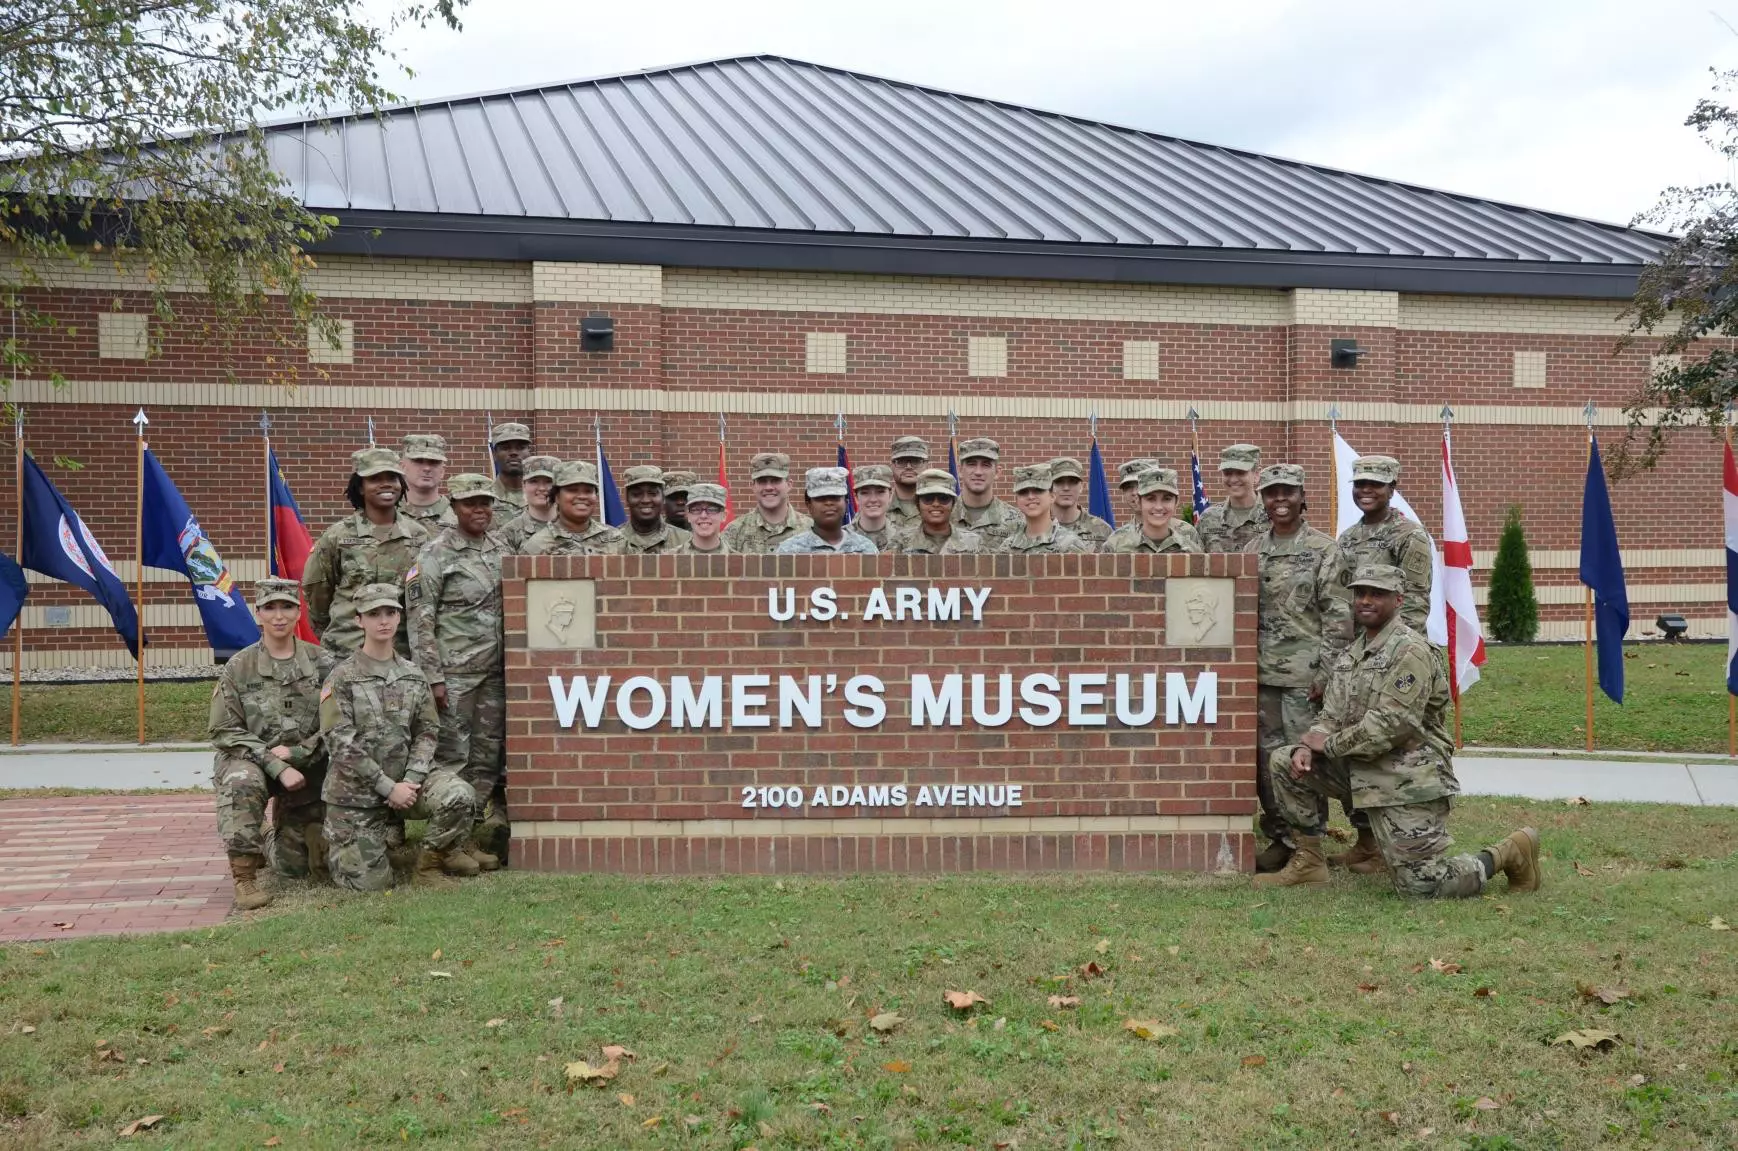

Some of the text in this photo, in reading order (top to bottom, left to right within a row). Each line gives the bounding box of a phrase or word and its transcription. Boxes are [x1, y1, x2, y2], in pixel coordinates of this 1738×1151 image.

[769, 587, 992, 621] U.S. ARMY
[548, 672, 1218, 730] WOMEN'S MUSEUM
[742, 785, 1022, 808] 2100 ADAMS AVENUE
